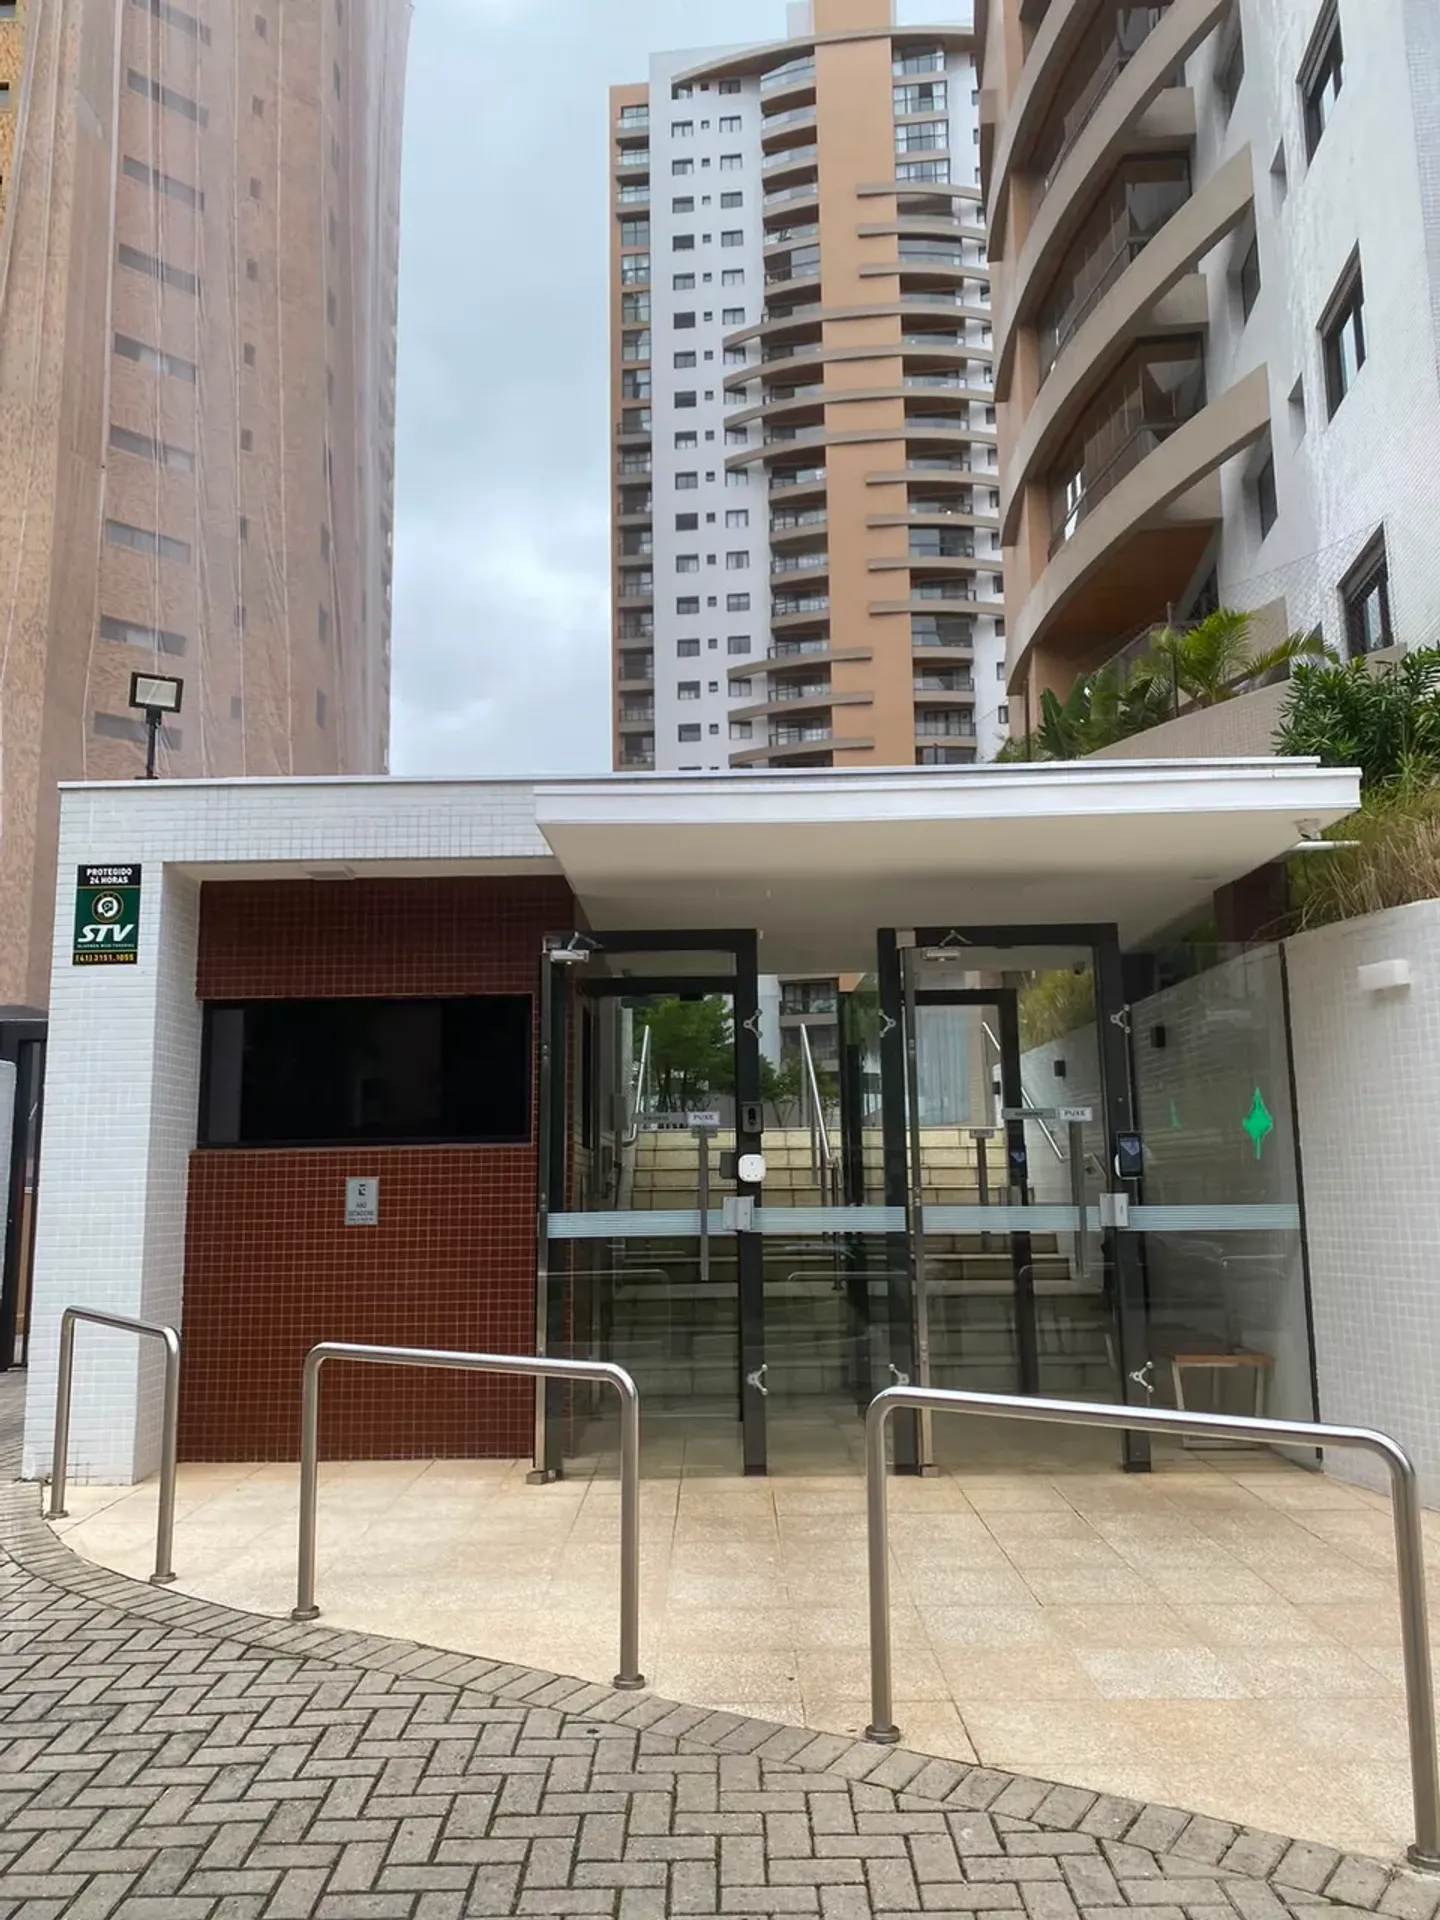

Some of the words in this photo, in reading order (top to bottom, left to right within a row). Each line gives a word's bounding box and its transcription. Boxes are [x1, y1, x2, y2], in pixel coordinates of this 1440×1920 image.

[86, 868, 133, 876] PROTEGIDO
[90, 877, 99, 885] 24
[101, 876, 128, 884] HORAS
[77, 924, 135, 942] STV
